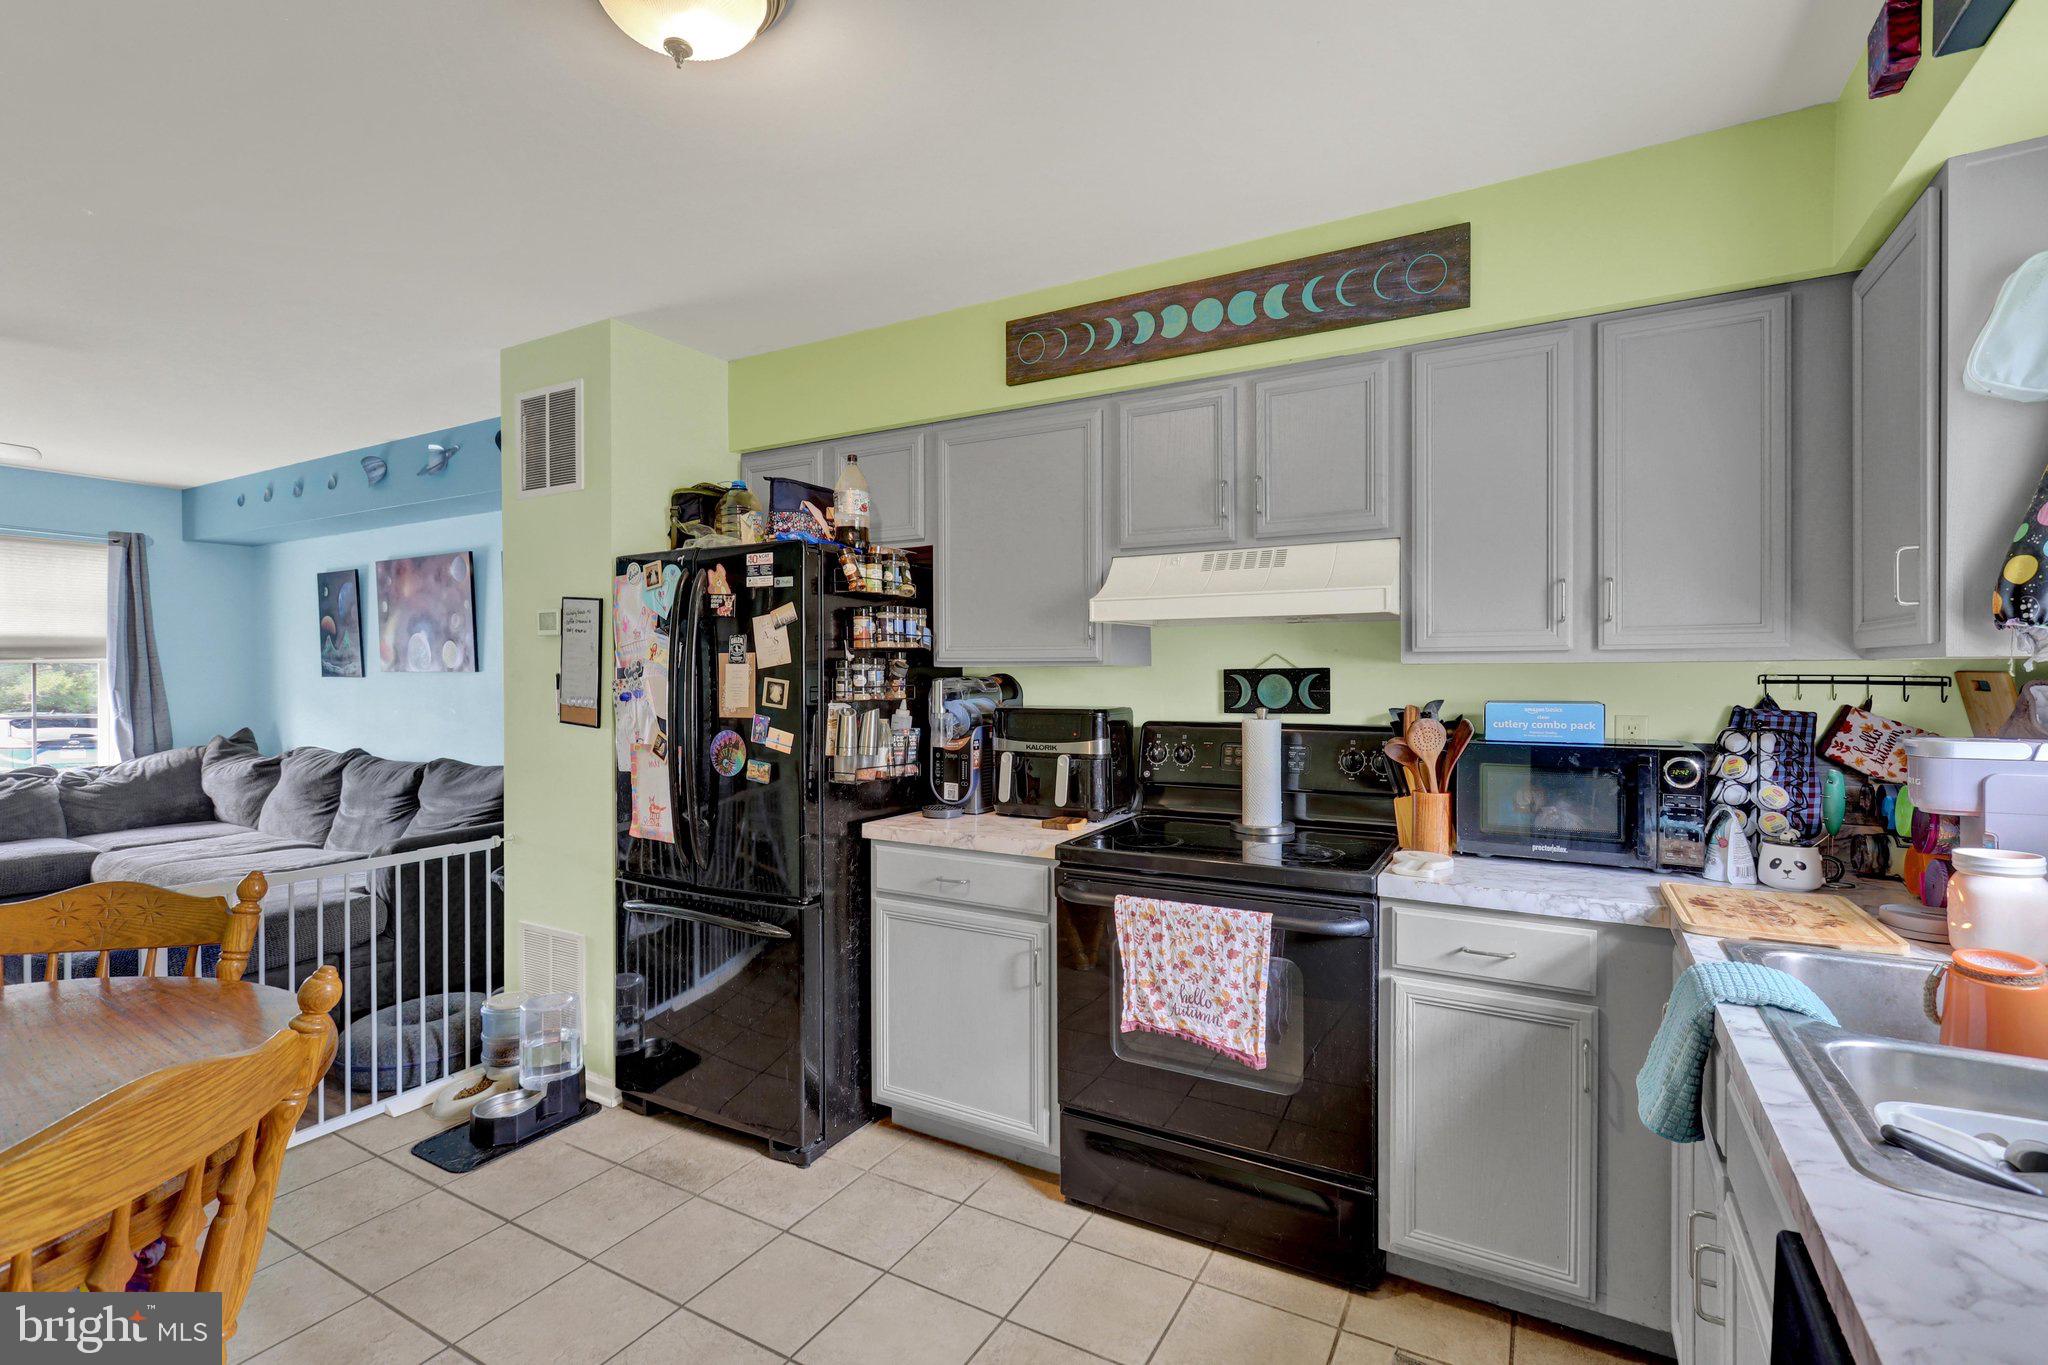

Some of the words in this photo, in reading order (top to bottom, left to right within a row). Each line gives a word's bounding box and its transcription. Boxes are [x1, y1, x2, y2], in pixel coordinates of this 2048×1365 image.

[1492, 719, 1529, 731] cutlery
[1531, 720, 1568, 730] combo
[1570, 721, 1597, 731] pack
[1025, 744, 1057, 752] KALORIK
[1852, 729, 1884, 757] hello
[1179, 984, 1213, 1010] hello
